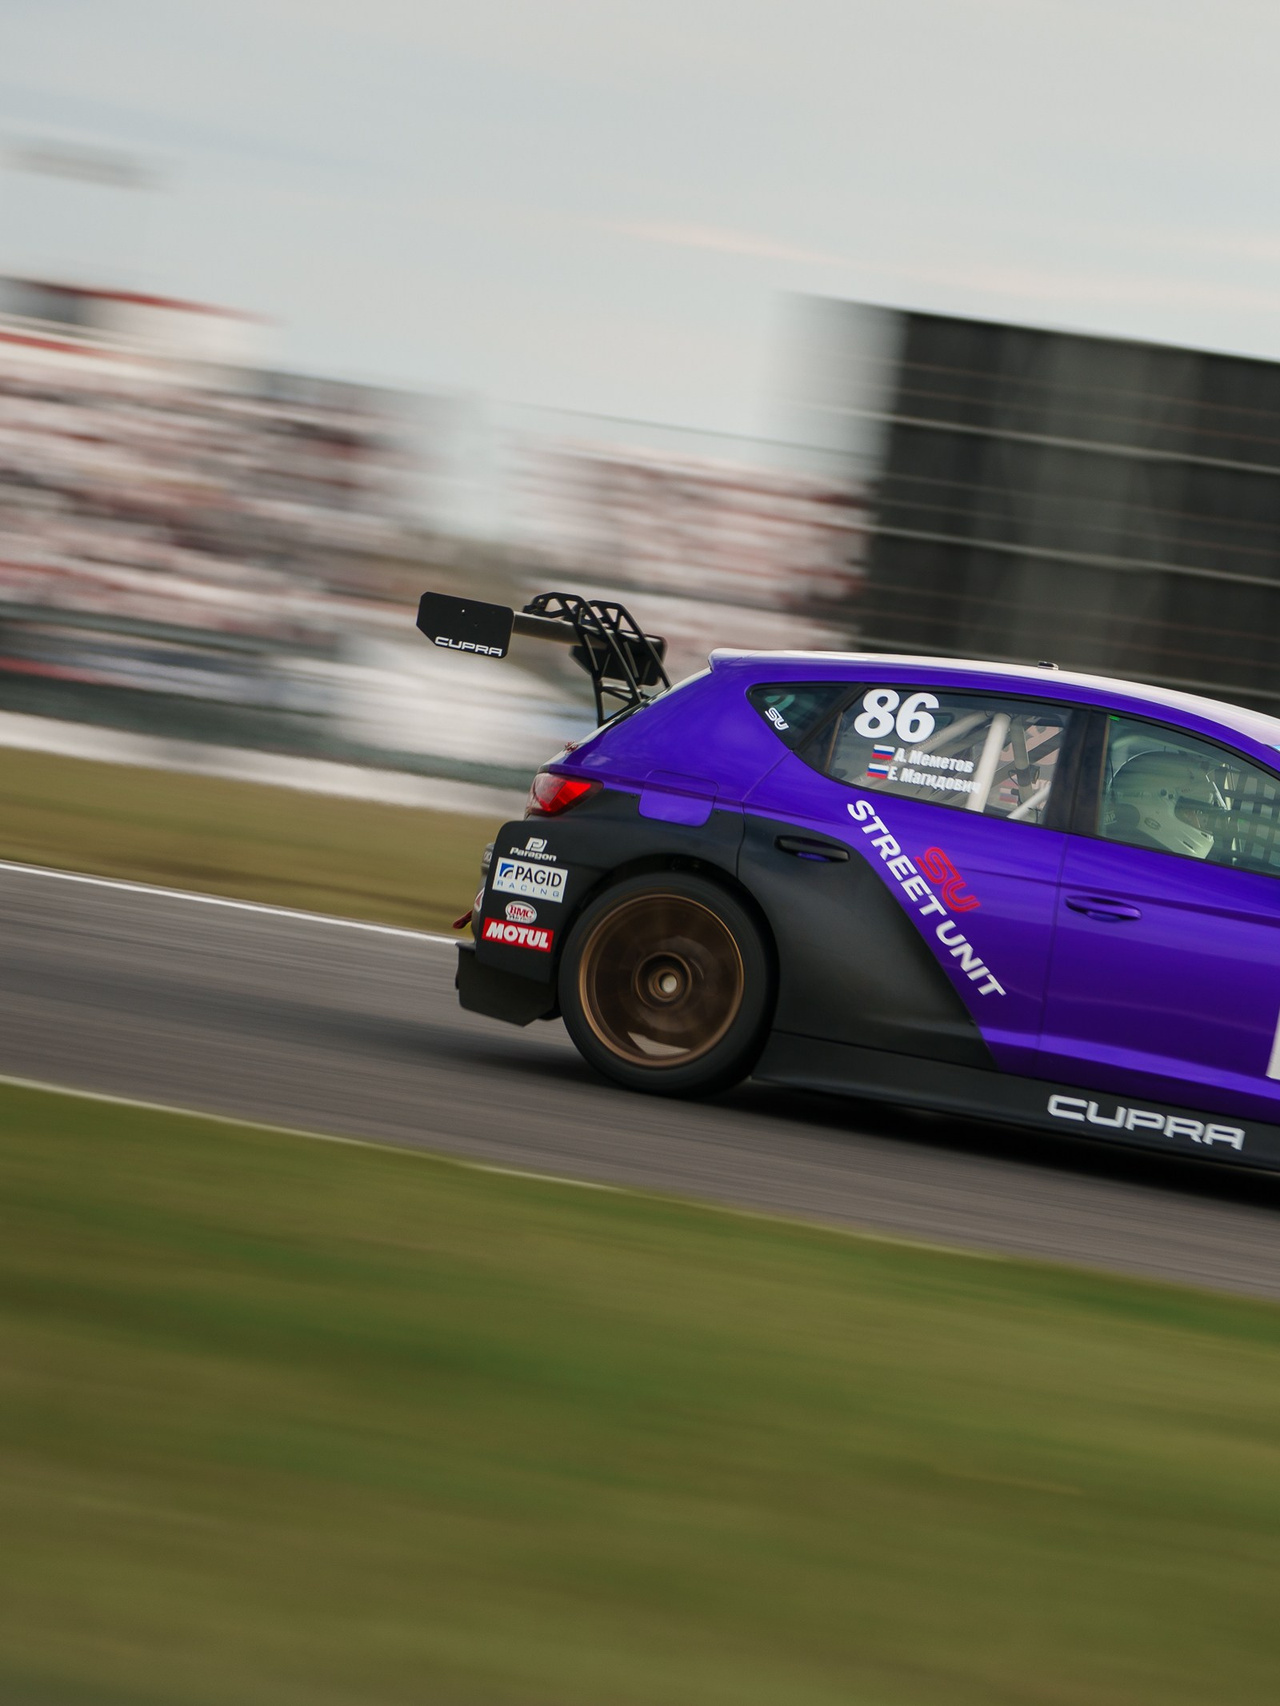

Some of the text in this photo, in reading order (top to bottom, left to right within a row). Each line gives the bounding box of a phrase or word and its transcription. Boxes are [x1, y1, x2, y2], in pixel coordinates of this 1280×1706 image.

[434, 636, 503, 657] CUPRA
[854, 688, 940, 743] 86
[893, 747, 975, 773] А. Меметов
[887, 765, 982, 794] Е. Магидович
[509, 846, 557, 862] Paragon
[496, 879, 560, 898] RACING
[514, 865, 562, 888] PAGID
[914, 846, 981, 913] SU
[509, 904, 534, 918] BMC
[846, 799, 1007, 996] STREET UNIT
[485, 921, 549, 949] MOTUL
[1047, 1094, 1246, 1151] CUPRA
